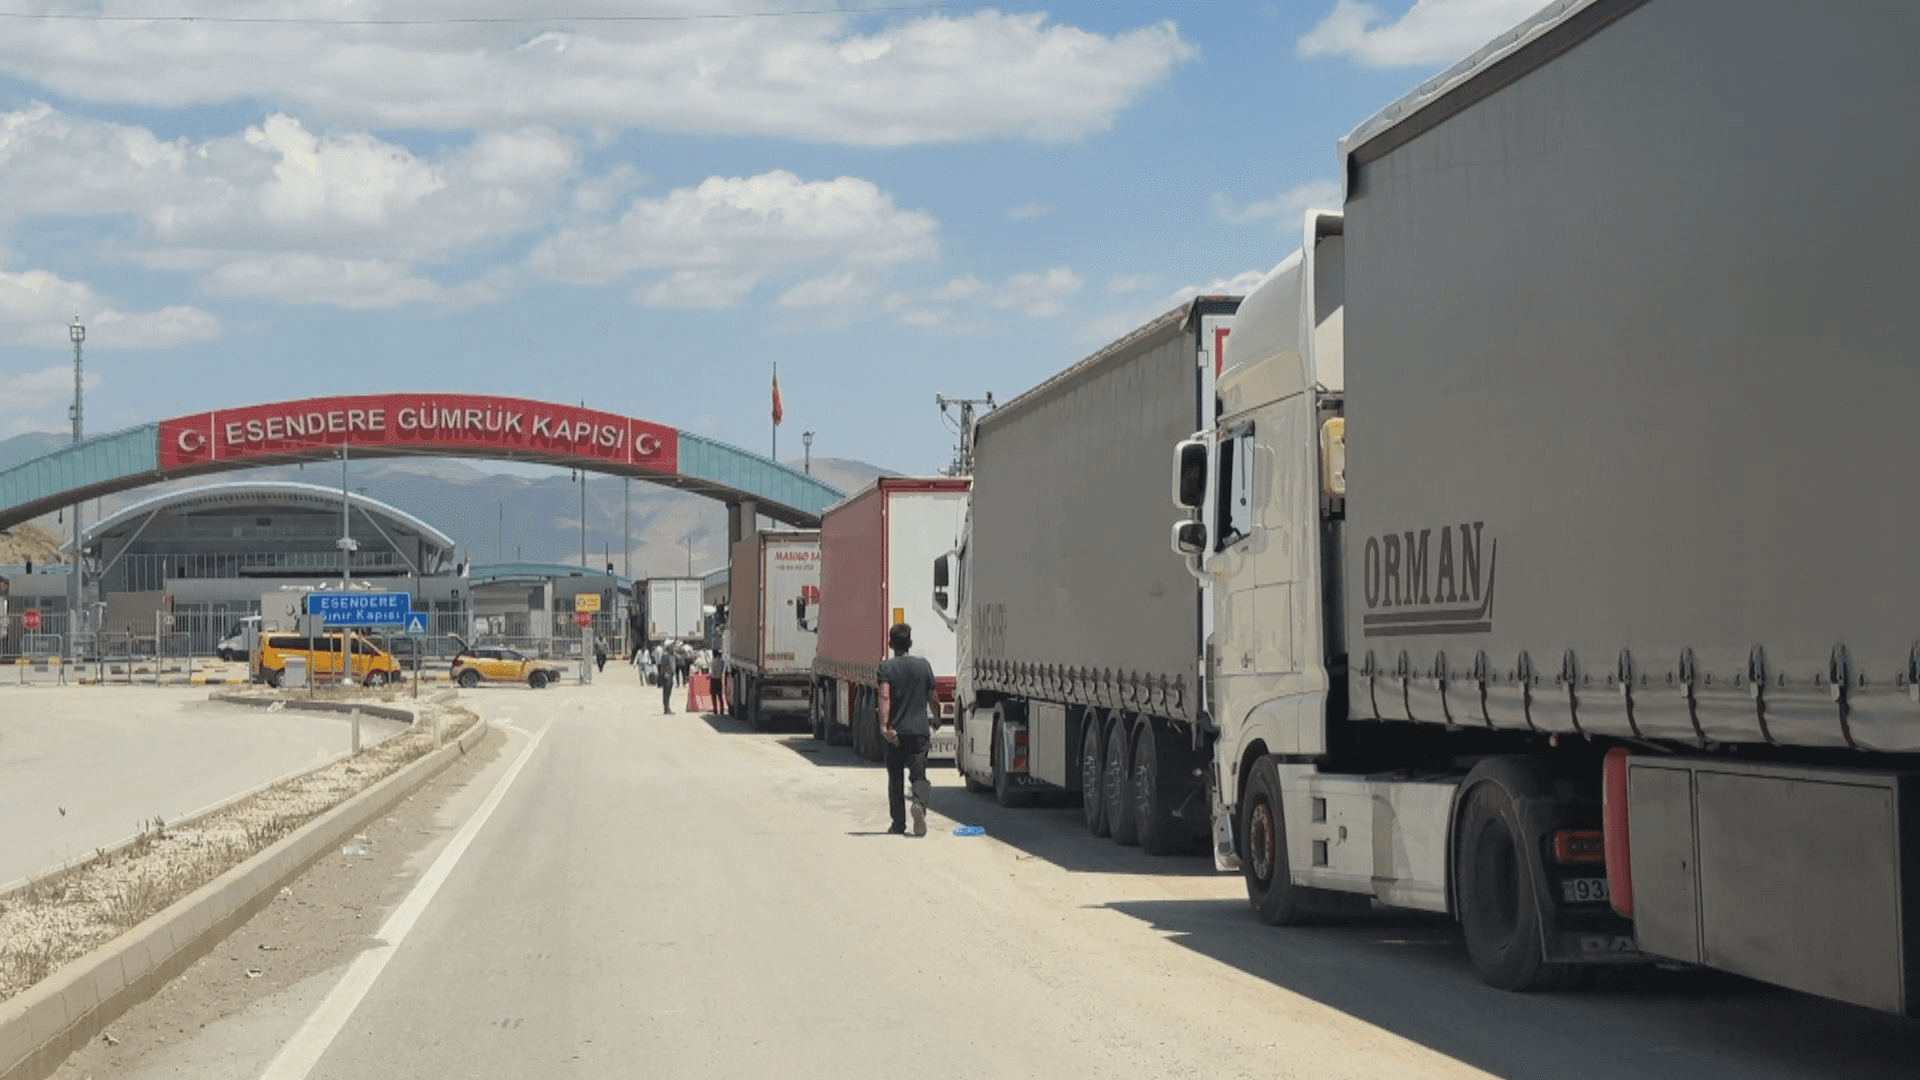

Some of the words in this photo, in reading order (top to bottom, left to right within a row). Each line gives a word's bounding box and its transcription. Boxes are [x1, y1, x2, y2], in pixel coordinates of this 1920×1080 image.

[225, 409, 386, 445] ESENDERE
[397, 401, 524, 433] GÜMRÜK
[532, 415, 625, 449] KAPISI
[1364, 521, 1484, 609] ORMAN
[320, 596, 398, 609] ESENDERE
[1576, 879, 1609, 899] 93
